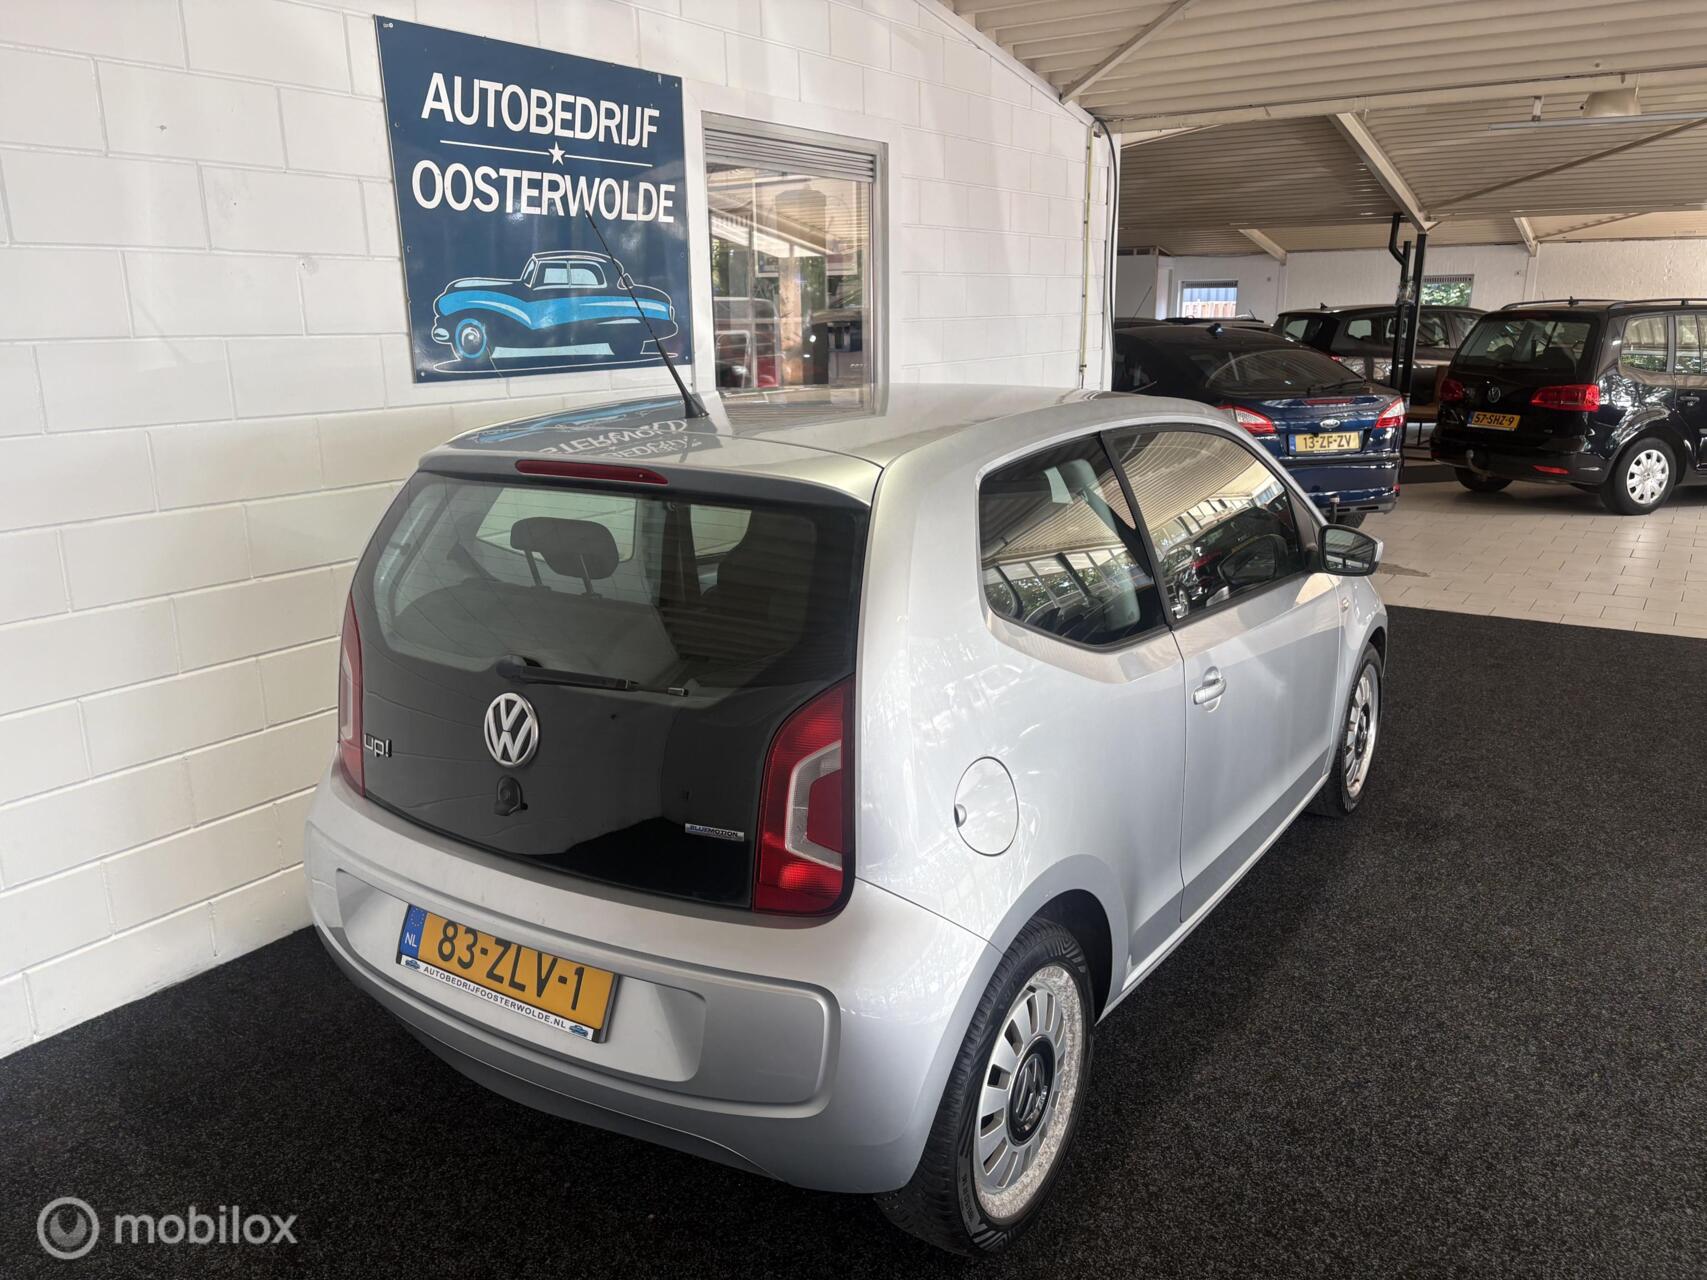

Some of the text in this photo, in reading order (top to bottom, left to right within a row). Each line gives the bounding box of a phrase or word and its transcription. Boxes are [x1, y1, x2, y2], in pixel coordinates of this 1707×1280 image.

[421, 72, 660, 148] AUTOBEDRIJF
[412, 159, 676, 223] OOSTERWOLDE
[1303, 434, 1352, 449] 13-ZF-ZV
[1474, 414, 1516, 426] 57-SHZ-9
[363, 734, 391, 758] up!
[404, 932, 418, 948] NL
[437, 919, 585, 1011] 83-ZLV-1
[422, 965, 567, 1030] AUTOBEDRIJFOOSTERWOLDE.NL
